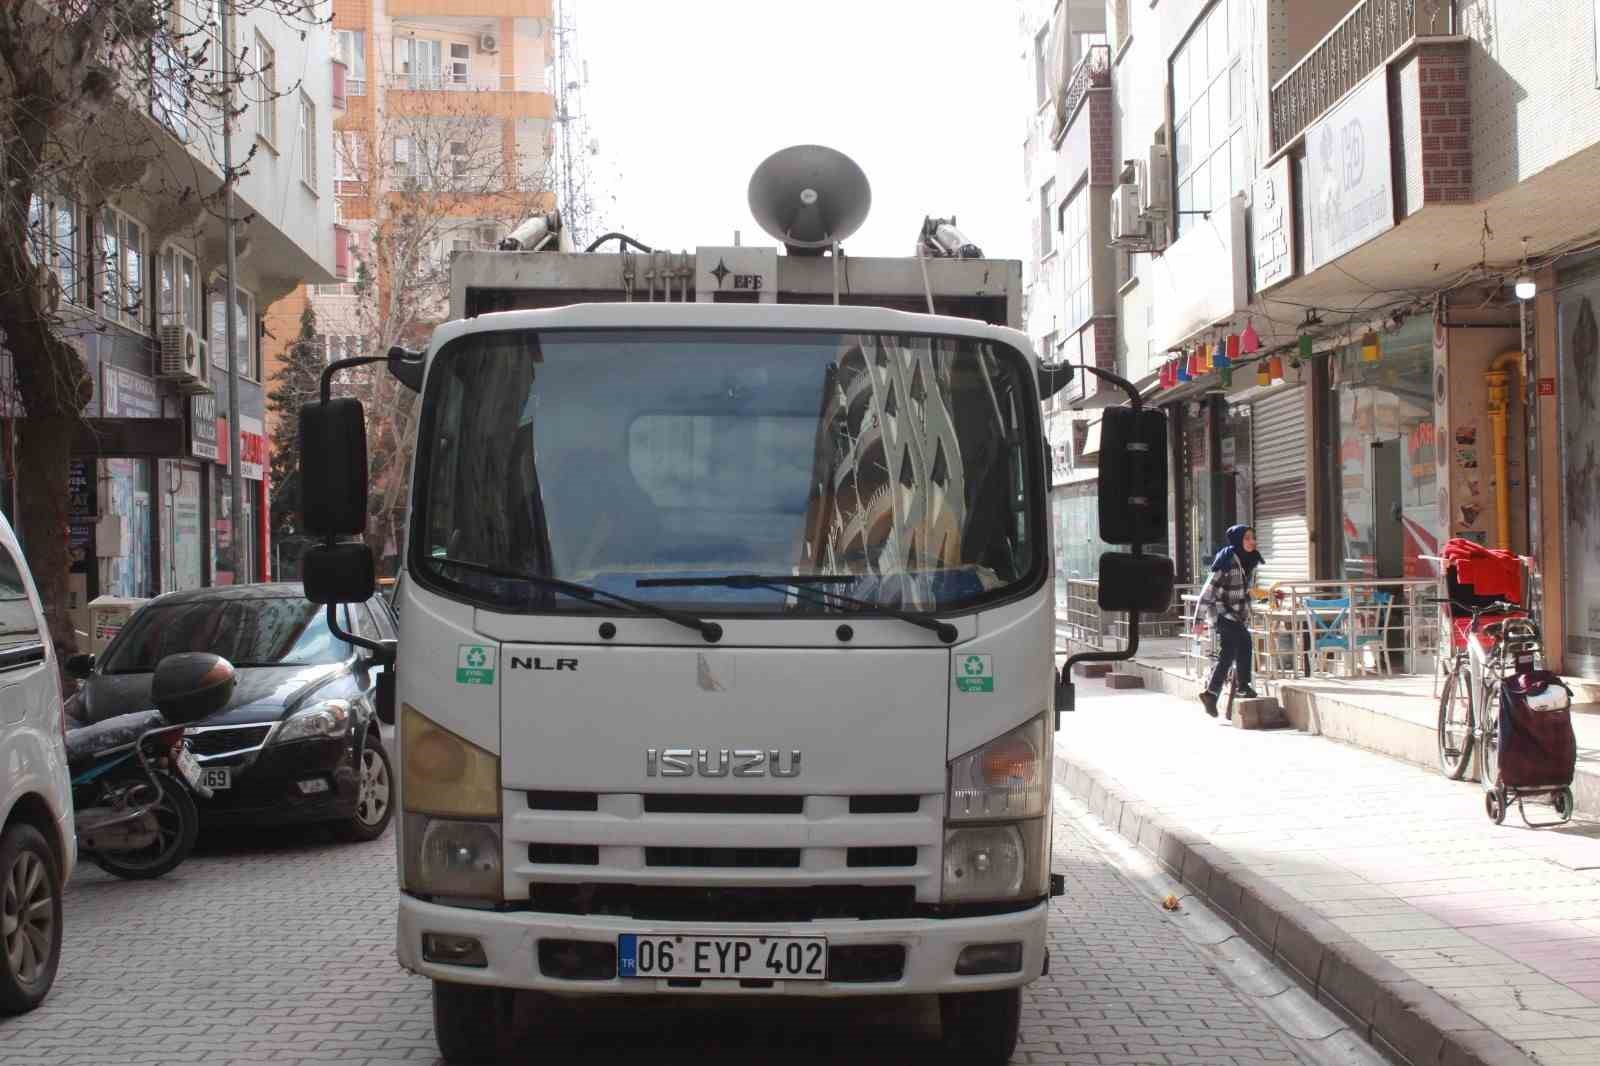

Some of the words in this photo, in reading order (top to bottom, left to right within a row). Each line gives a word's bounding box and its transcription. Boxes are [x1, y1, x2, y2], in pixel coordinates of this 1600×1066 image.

[510, 656, 579, 671] NLR
[646, 748, 801, 778] ISUZU
[622, 957, 635, 968] TR
[638, 940, 674, 973] 06
[694, 941, 751, 973] EYP
[766, 942, 822, 974] 402
